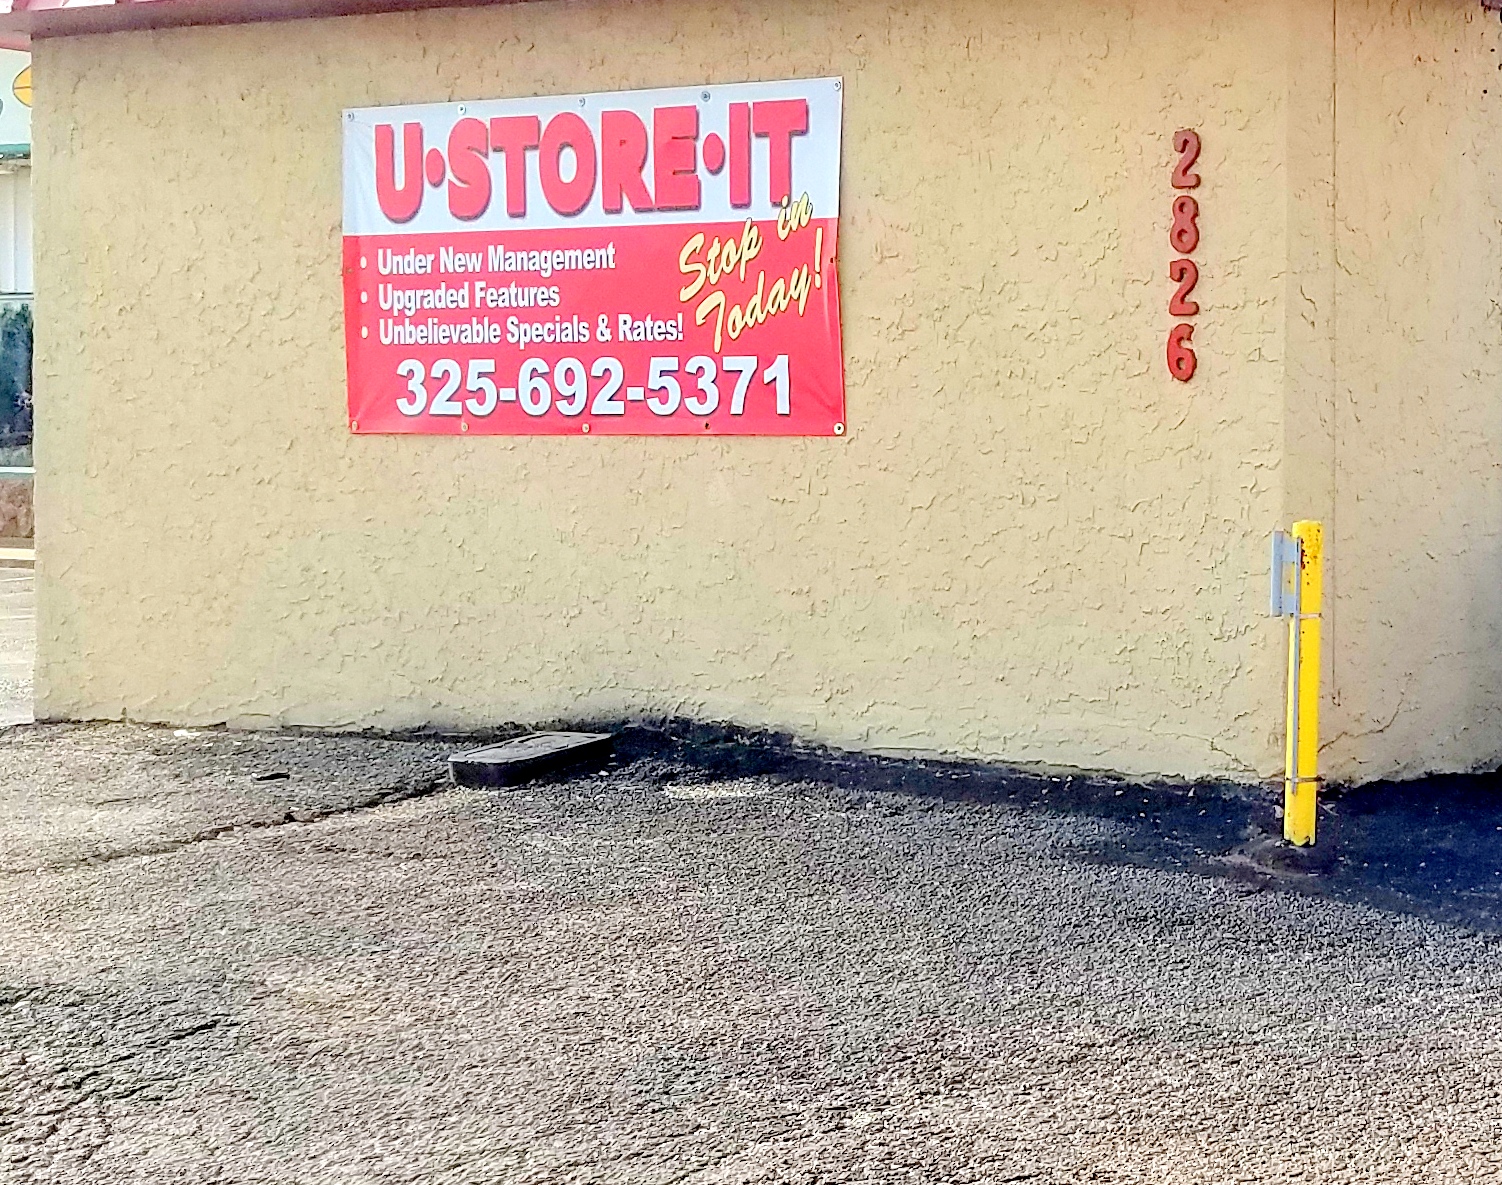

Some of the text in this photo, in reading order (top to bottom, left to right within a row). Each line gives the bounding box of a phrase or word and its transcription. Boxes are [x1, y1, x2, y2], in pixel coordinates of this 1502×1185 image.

[377, 242, 616, 278] Under New Management
[678, 191, 813, 302] Stop in
[1167, 129, 1201, 382] 2826
[378, 281, 560, 317] Upgraded Features
[695, 227, 823, 353] Today!
[379, 313, 683, 350] Unbelievable Specials & Rates!
[396, 354, 792, 416] 325-692-5371
